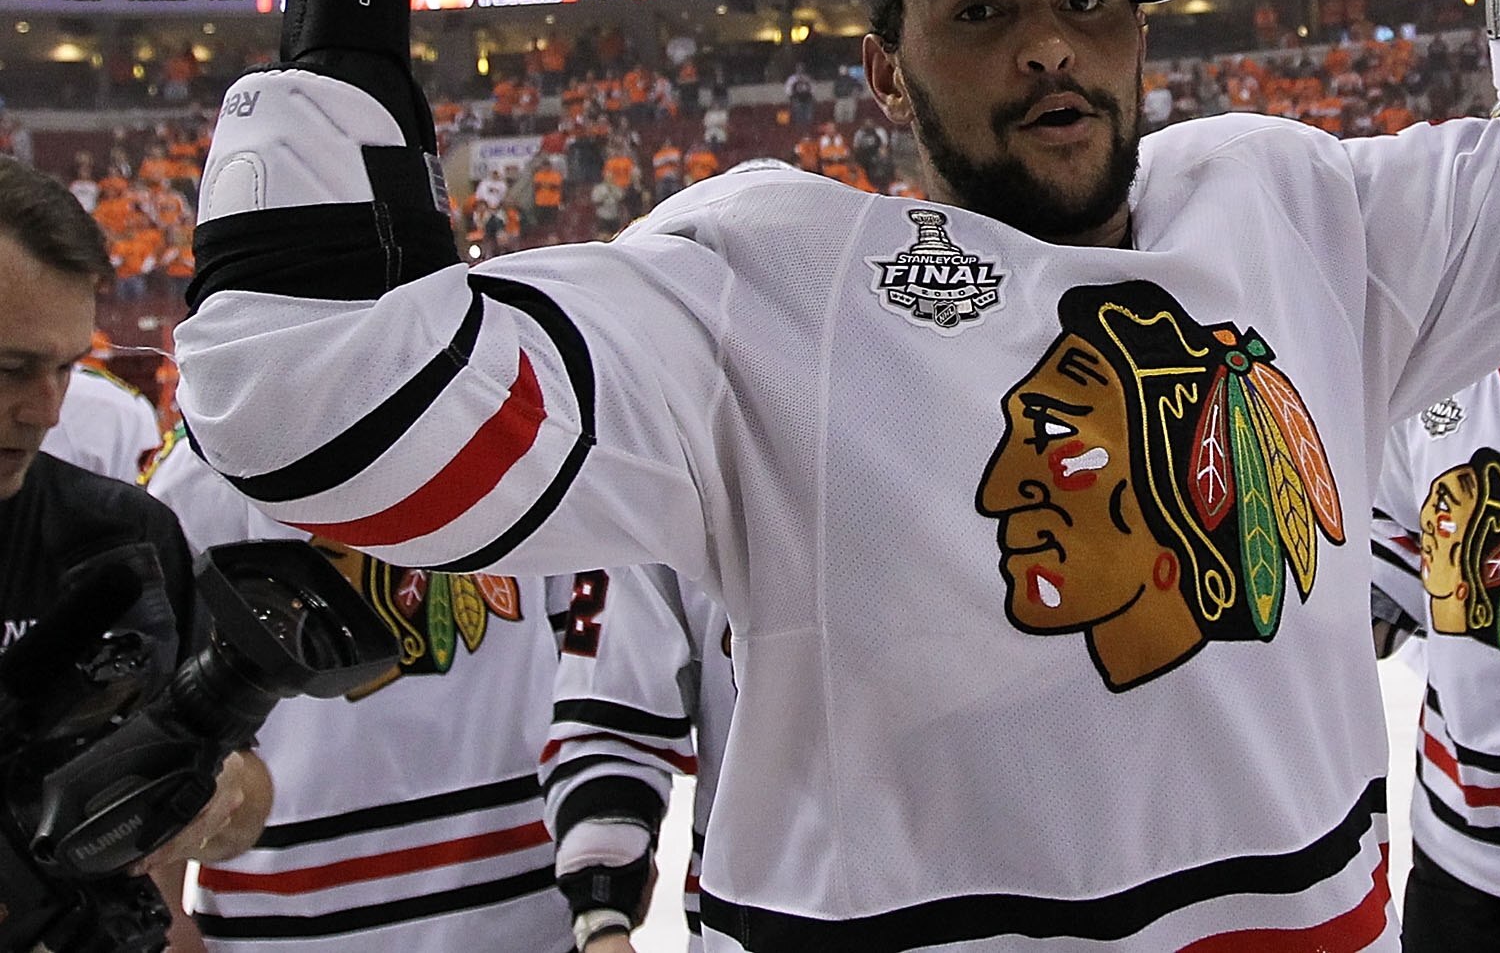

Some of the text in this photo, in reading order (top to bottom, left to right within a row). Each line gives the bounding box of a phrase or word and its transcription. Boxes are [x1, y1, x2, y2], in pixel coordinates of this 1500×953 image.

[897, 254, 977, 265] STANLEY CUP
[884, 265, 998, 284] FINAL
[921, 289, 966, 297] 2010
[938, 305, 955, 323] NHL
